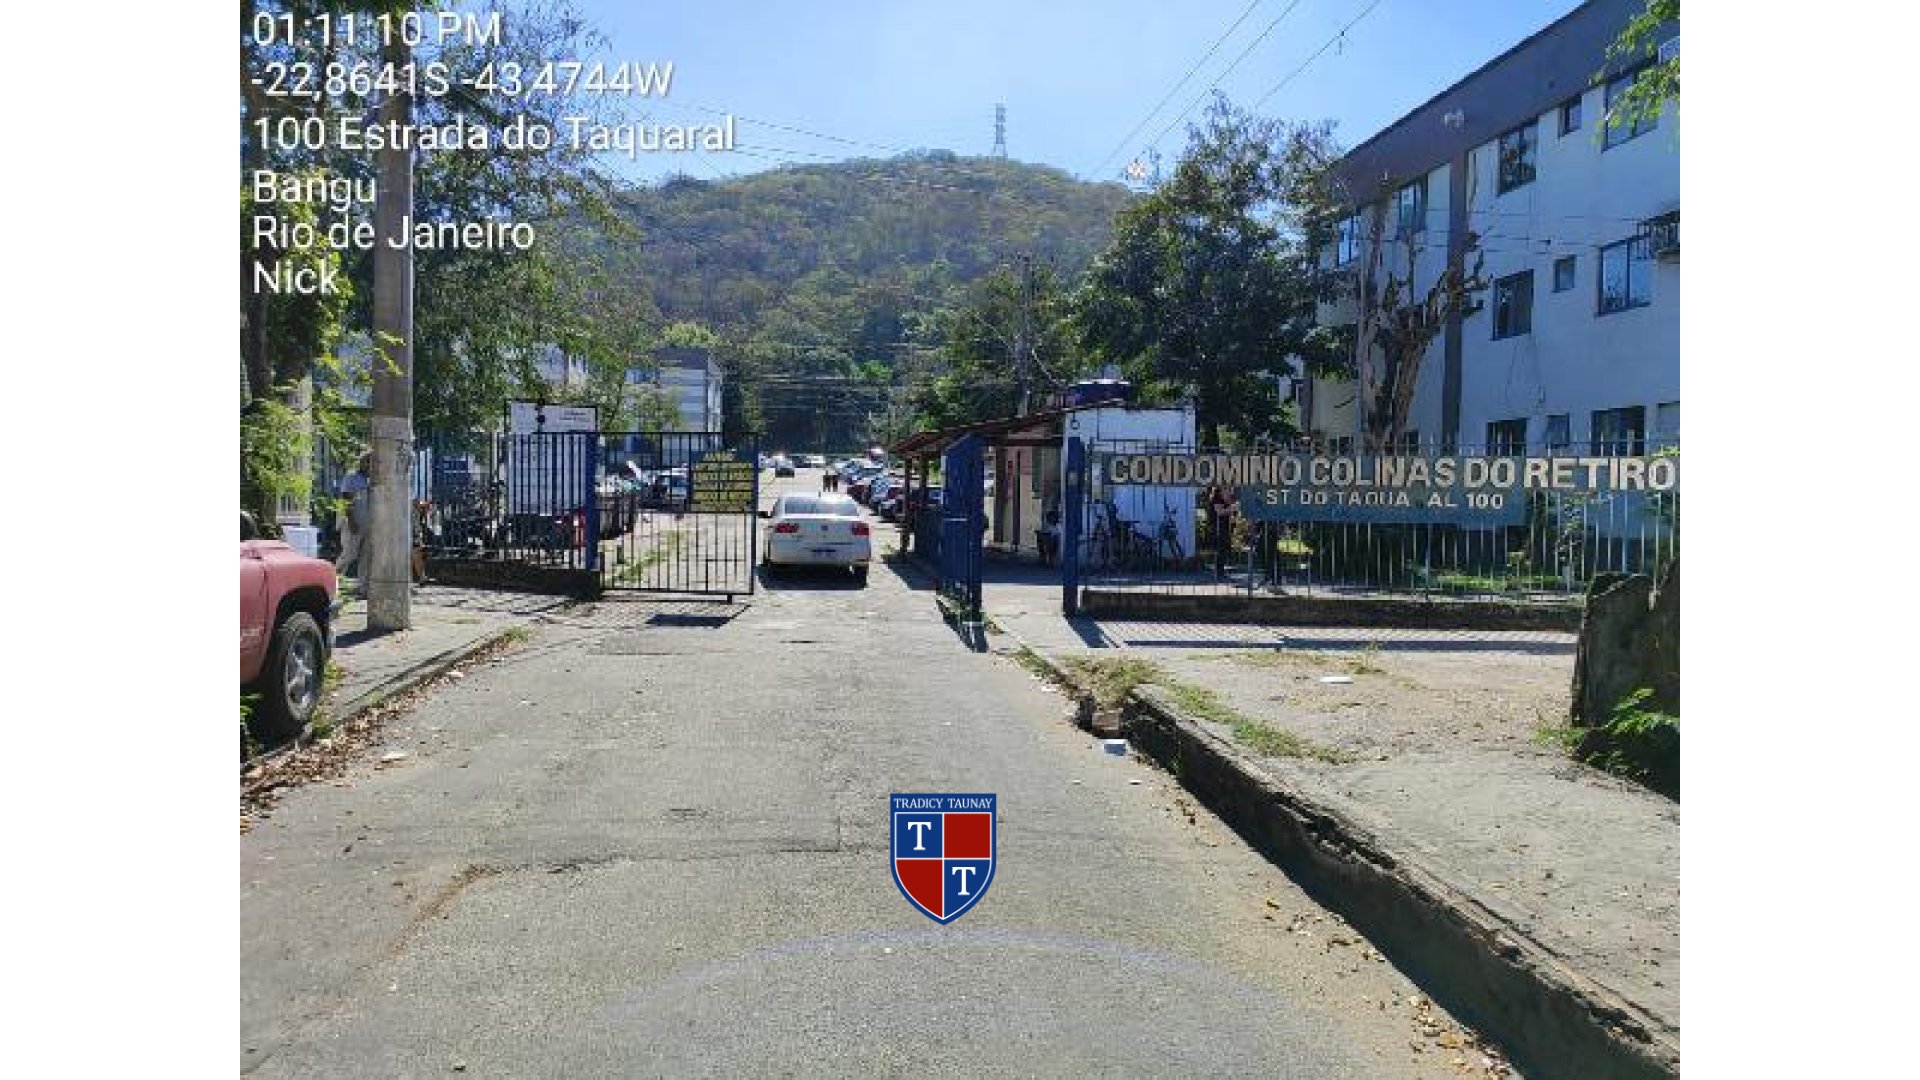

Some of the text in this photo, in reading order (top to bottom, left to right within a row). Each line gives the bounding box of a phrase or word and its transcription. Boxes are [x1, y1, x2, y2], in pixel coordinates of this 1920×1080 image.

[1110, 454, 1676, 491] CONDOMINIO COLINAS DO RETIRO
[1300, 489, 1327, 505] DO
[1466, 493, 1503, 510] 100
